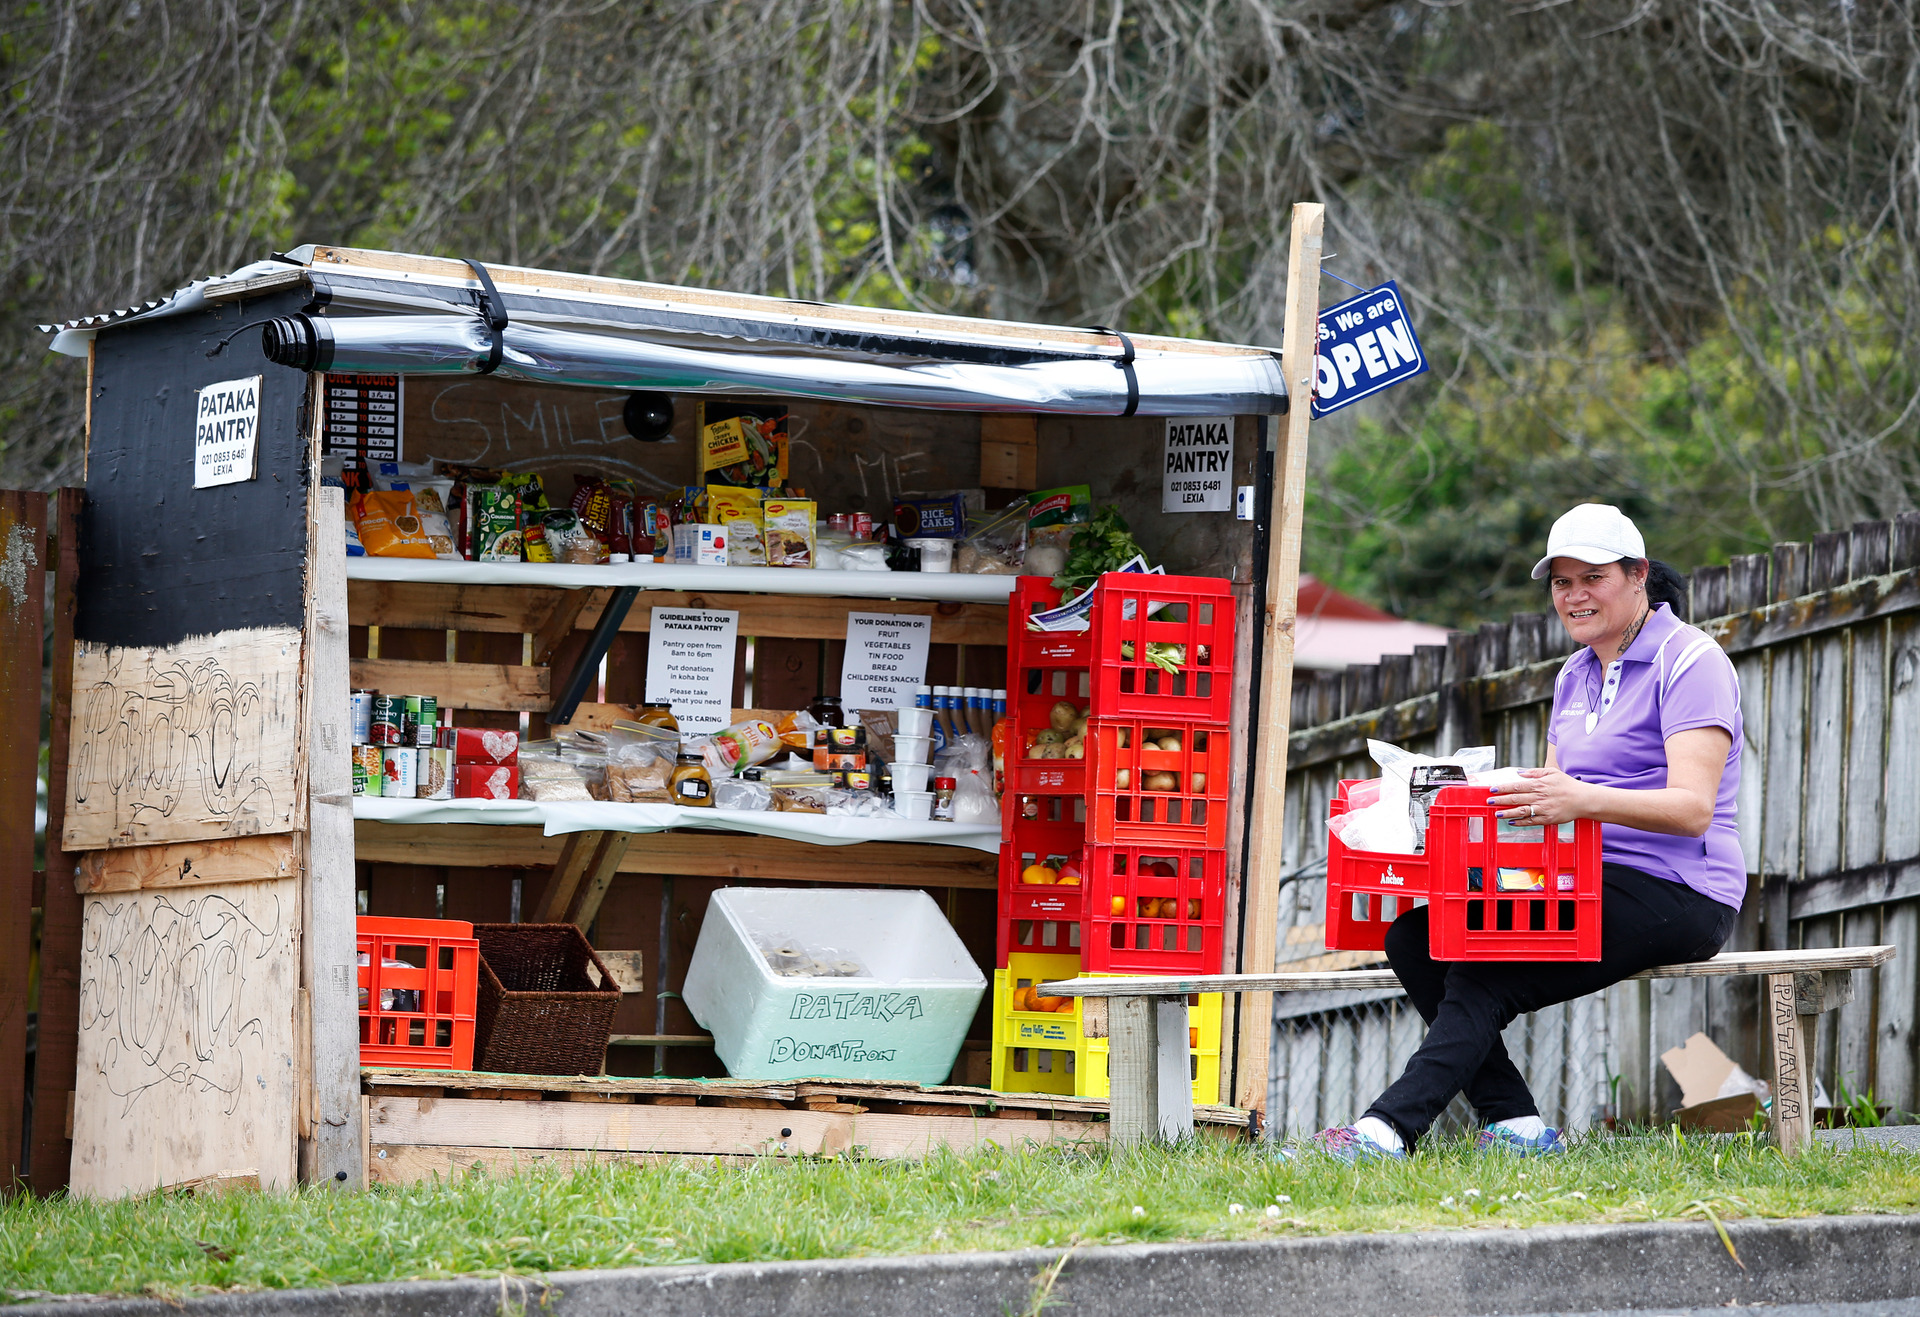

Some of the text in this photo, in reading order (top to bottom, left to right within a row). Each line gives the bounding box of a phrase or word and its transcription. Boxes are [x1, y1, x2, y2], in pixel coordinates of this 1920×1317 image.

[1335, 311, 1364, 332] We
[1366, 298, 1395, 319] are
[1311, 319, 1417, 399] OPEN
[200, 387, 256, 418] PATAKA
[198, 415, 256, 447] PANTRY
[1169, 423, 1229, 447] PATAKA
[708, 435, 739, 449] CHICKEN
[202, 448, 247, 465] 021 0853 6481
[1166, 450, 1230, 474] PANTRY
[213, 464, 233, 476] LEXIA
[1170, 480, 1221, 491] 021 0853 6481
[1182, 493, 1204, 503] LEXIA
[1029, 496, 1068, 518] Continental
[921, 509, 944, 519] RICE
[921, 517, 954, 528] CAKES
[659, 613, 701, 622] GUIDELINES
[664, 622, 723, 632] PATAKA PANTRY
[875, 619, 912, 628] DONATION
[913, 621, 925, 629] OF:
[662, 640, 722, 650] Pantry open from
[864, 641, 911, 650] VEGETABLES
[697, 651, 712, 659] 6pm
[868, 652, 904, 661] TIN FOOD
[680, 665, 714, 673] donations
[678, 673, 695, 681] koha
[847, 673, 920, 683] CHILDRENS SNACKS
[670, 687, 692, 695] Please
[868, 686, 897, 694] CEREAL
[690, 698, 703, 706] you
[694, 715, 722, 723] CARING
[743, 726, 760, 748] THIN
[1380, 873, 1404, 886] Anchor
[790, 992, 923, 1022] PATAKA
[1774, 984, 1801, 1122] PATAKA
